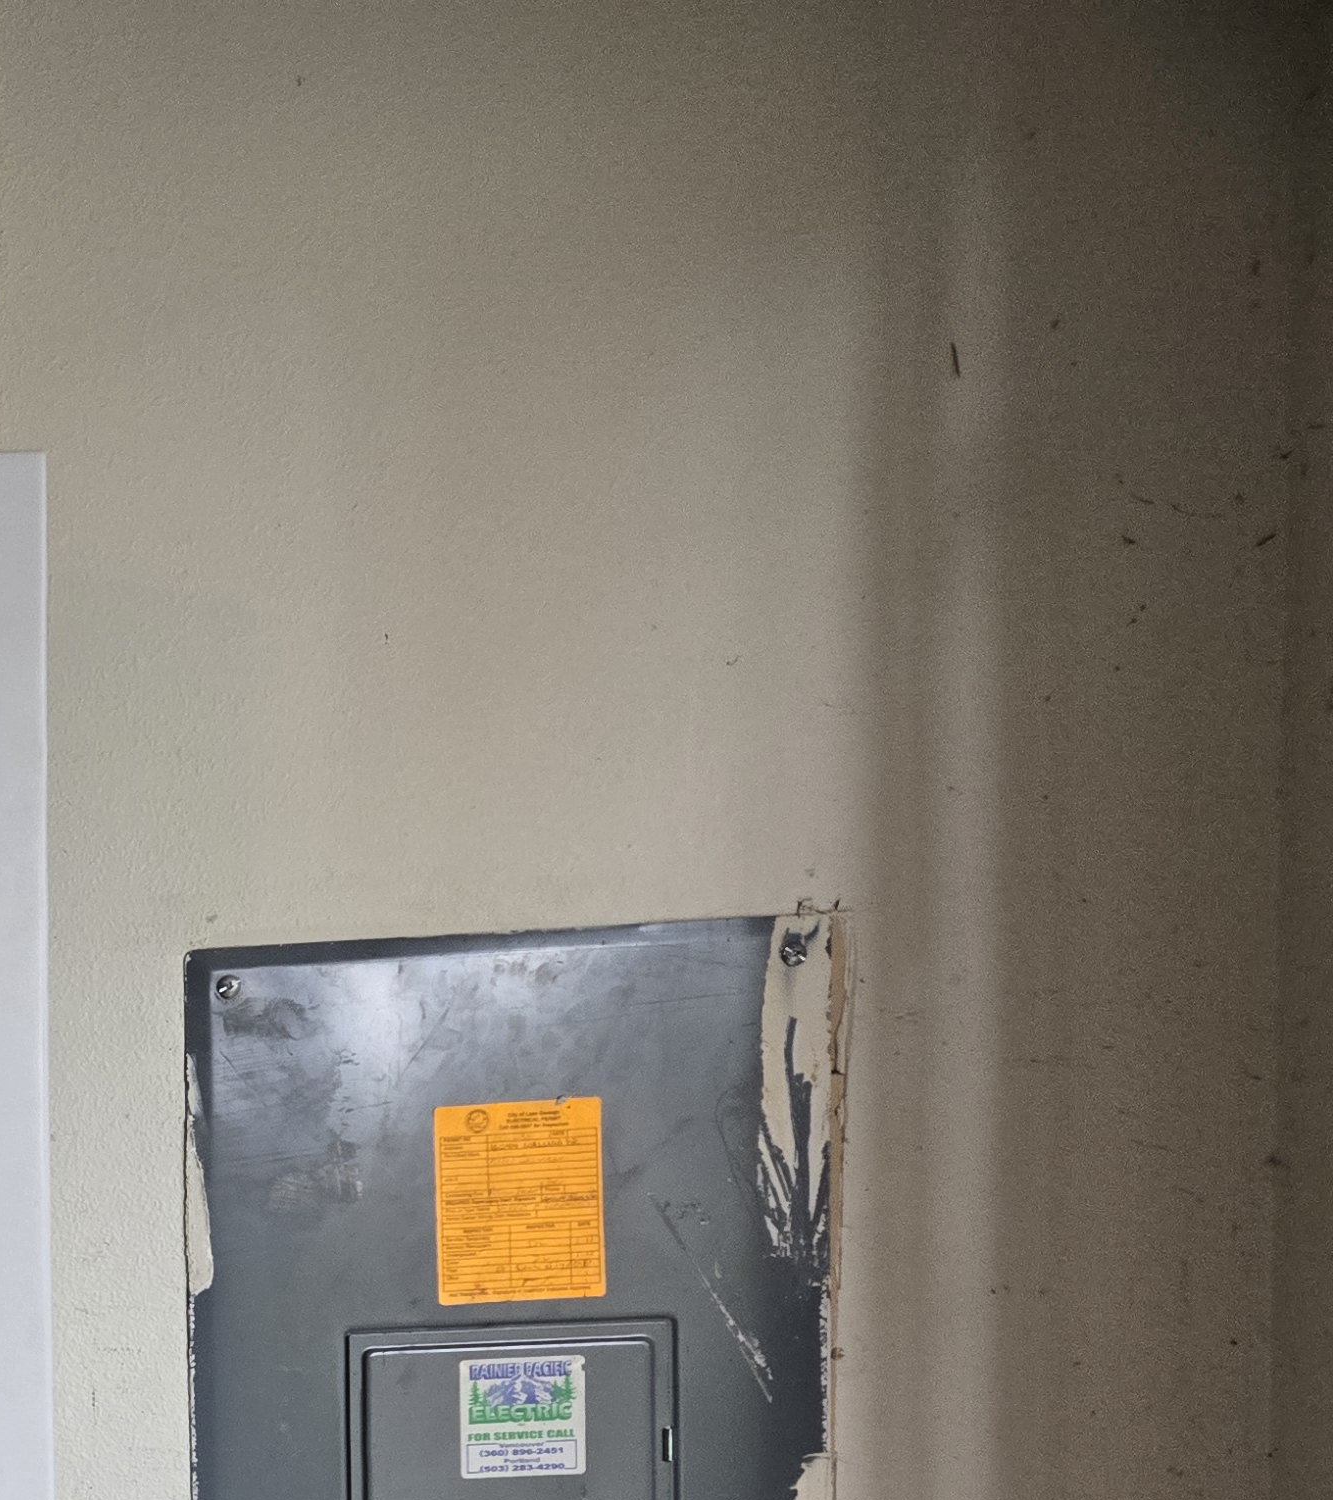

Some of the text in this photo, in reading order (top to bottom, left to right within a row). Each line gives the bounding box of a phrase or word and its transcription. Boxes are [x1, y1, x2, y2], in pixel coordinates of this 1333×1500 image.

[469, 1402, 572, 1425] ELECTRIC
[468, 1429, 575, 1441] FOR SERVICE CALL
